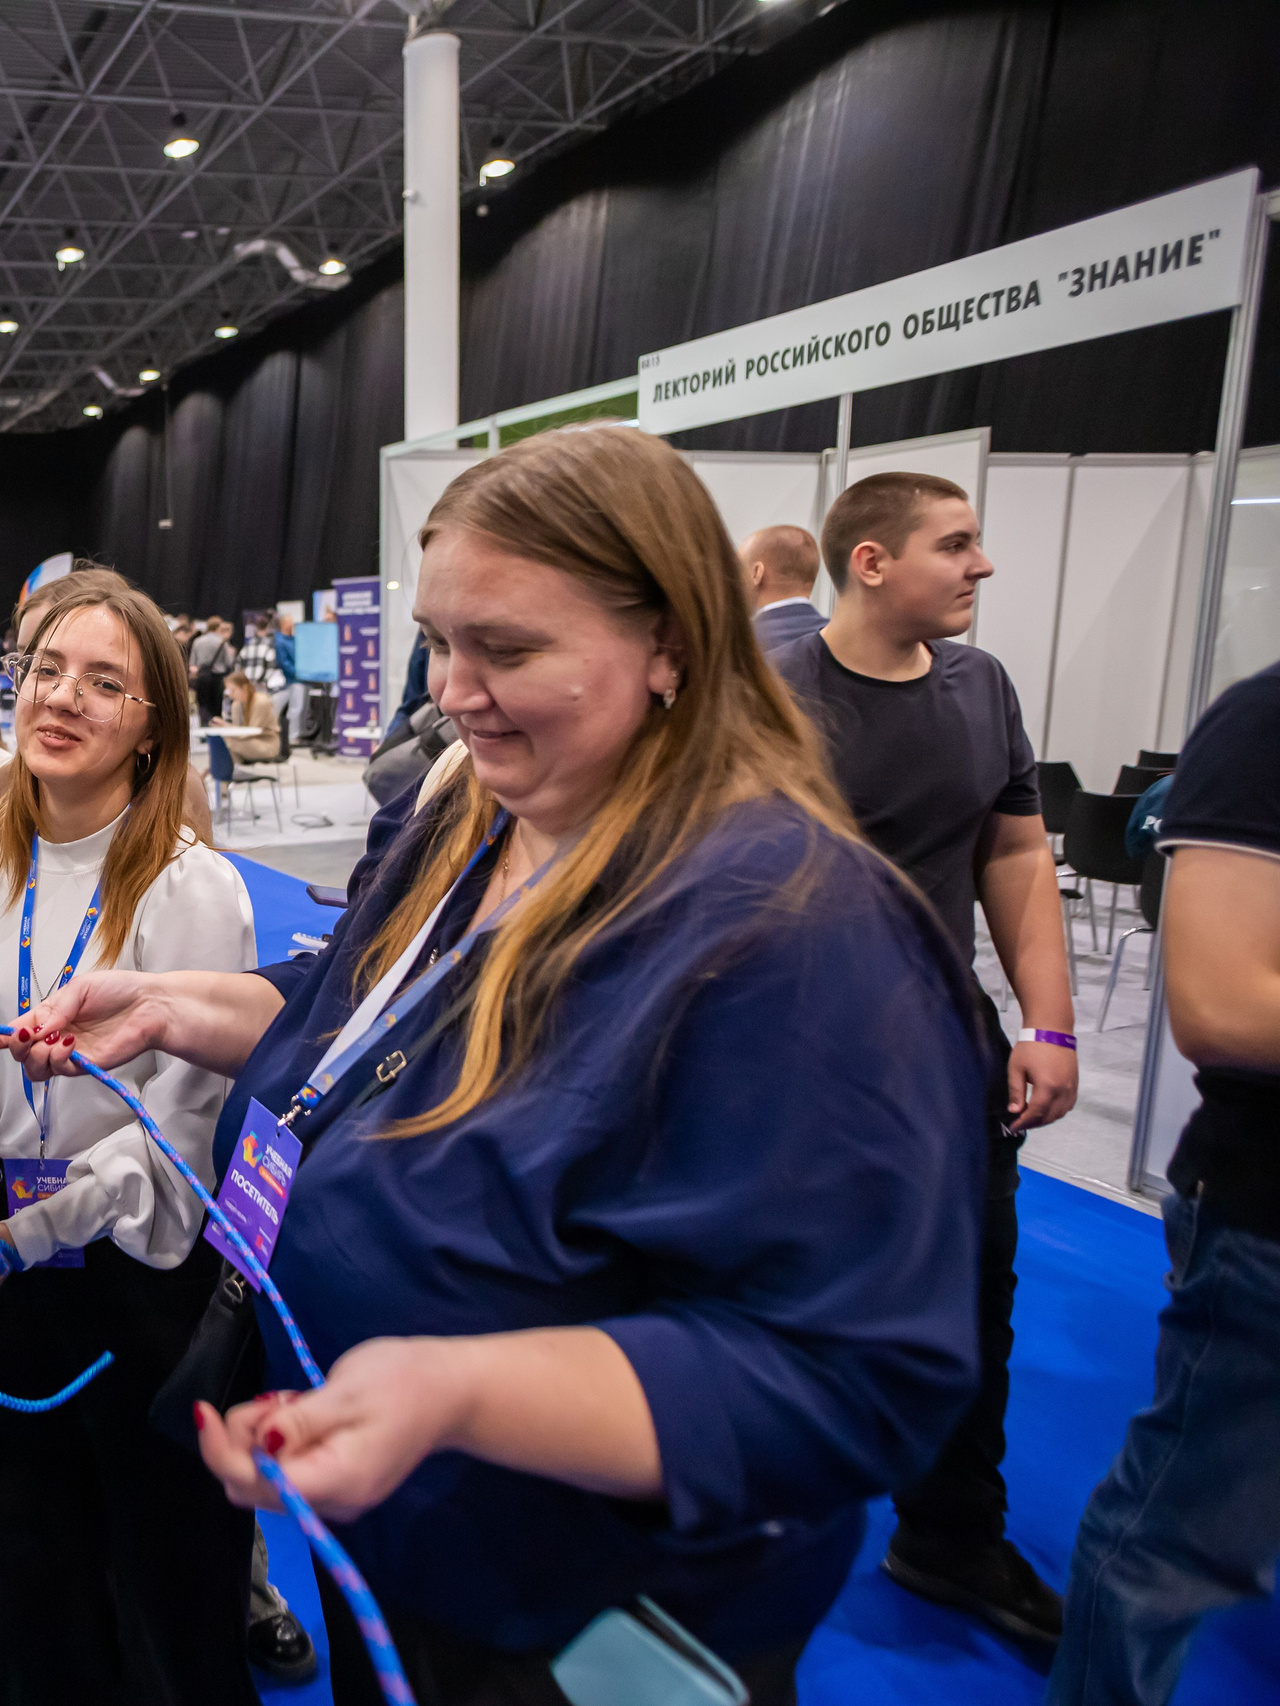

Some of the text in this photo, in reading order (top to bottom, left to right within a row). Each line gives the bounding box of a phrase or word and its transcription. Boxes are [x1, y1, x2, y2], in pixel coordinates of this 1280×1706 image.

[652, 229, 1221, 403] ЛЕКТОРИЙ РОССИЙСКОГО ОБЩЕСТВА "ЗНАНИЕ"
[36, 1176, 67, 1184] УЧЕБНА
[231, 1168, 279, 1226] ПОСЕТИТЕЛЬ
